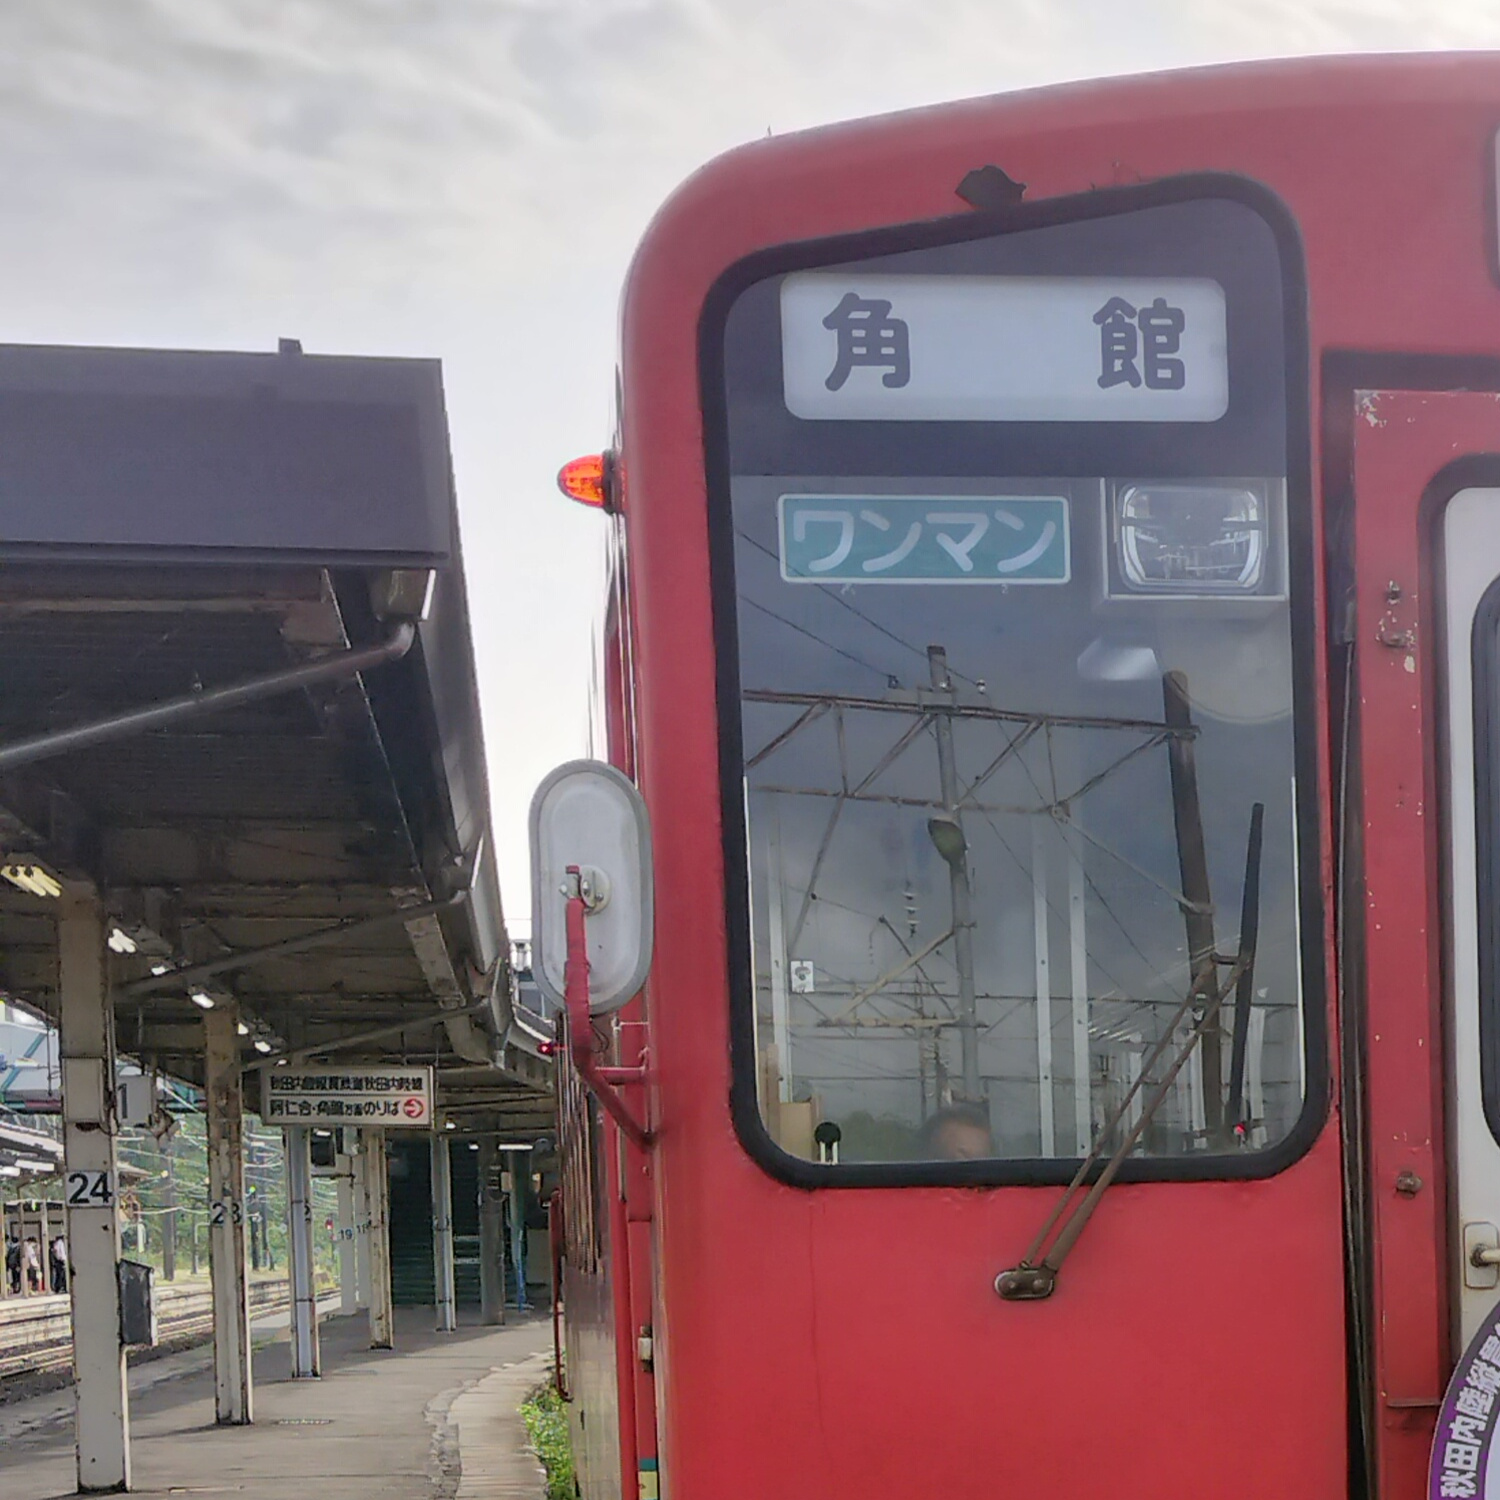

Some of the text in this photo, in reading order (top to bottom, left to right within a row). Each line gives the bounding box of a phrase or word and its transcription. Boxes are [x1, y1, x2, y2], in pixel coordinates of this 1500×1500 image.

[793, 510, 1056, 572] ワンマン
[68, 1172, 112, 1203] 24
